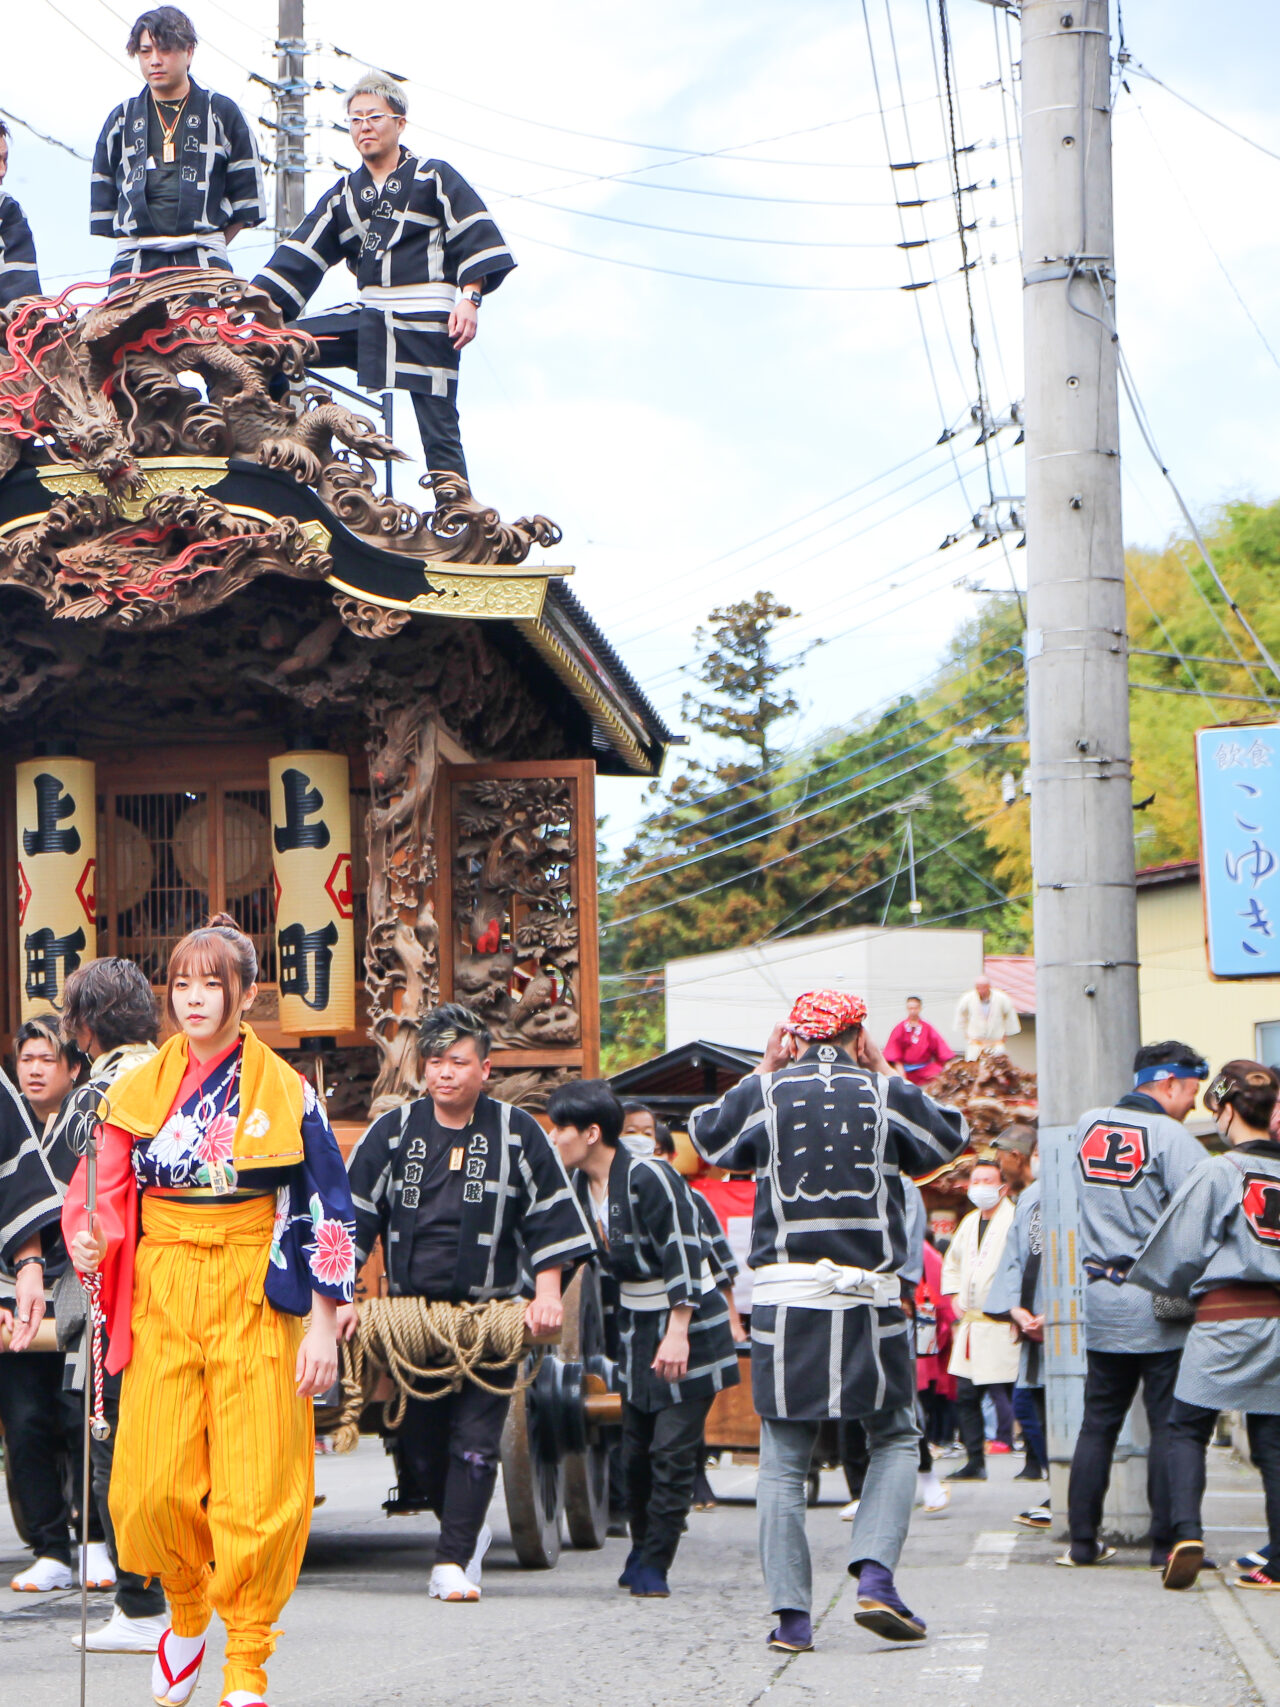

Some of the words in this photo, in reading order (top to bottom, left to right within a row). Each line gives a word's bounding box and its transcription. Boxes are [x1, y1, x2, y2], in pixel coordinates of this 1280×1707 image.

[182, 135, 199, 182] 上町
[365, 200, 392, 251] 上町
[1214, 740, 1273, 769] 飲食
[23, 773, 87, 1010] 上町
[274, 768, 339, 1011] 上町
[1224, 783, 1276, 955] こゆき
[402, 1138, 426, 1209] 上町睦
[463, 1133, 488, 1203] 上町睦
[1087, 1132, 1134, 1173] 上
